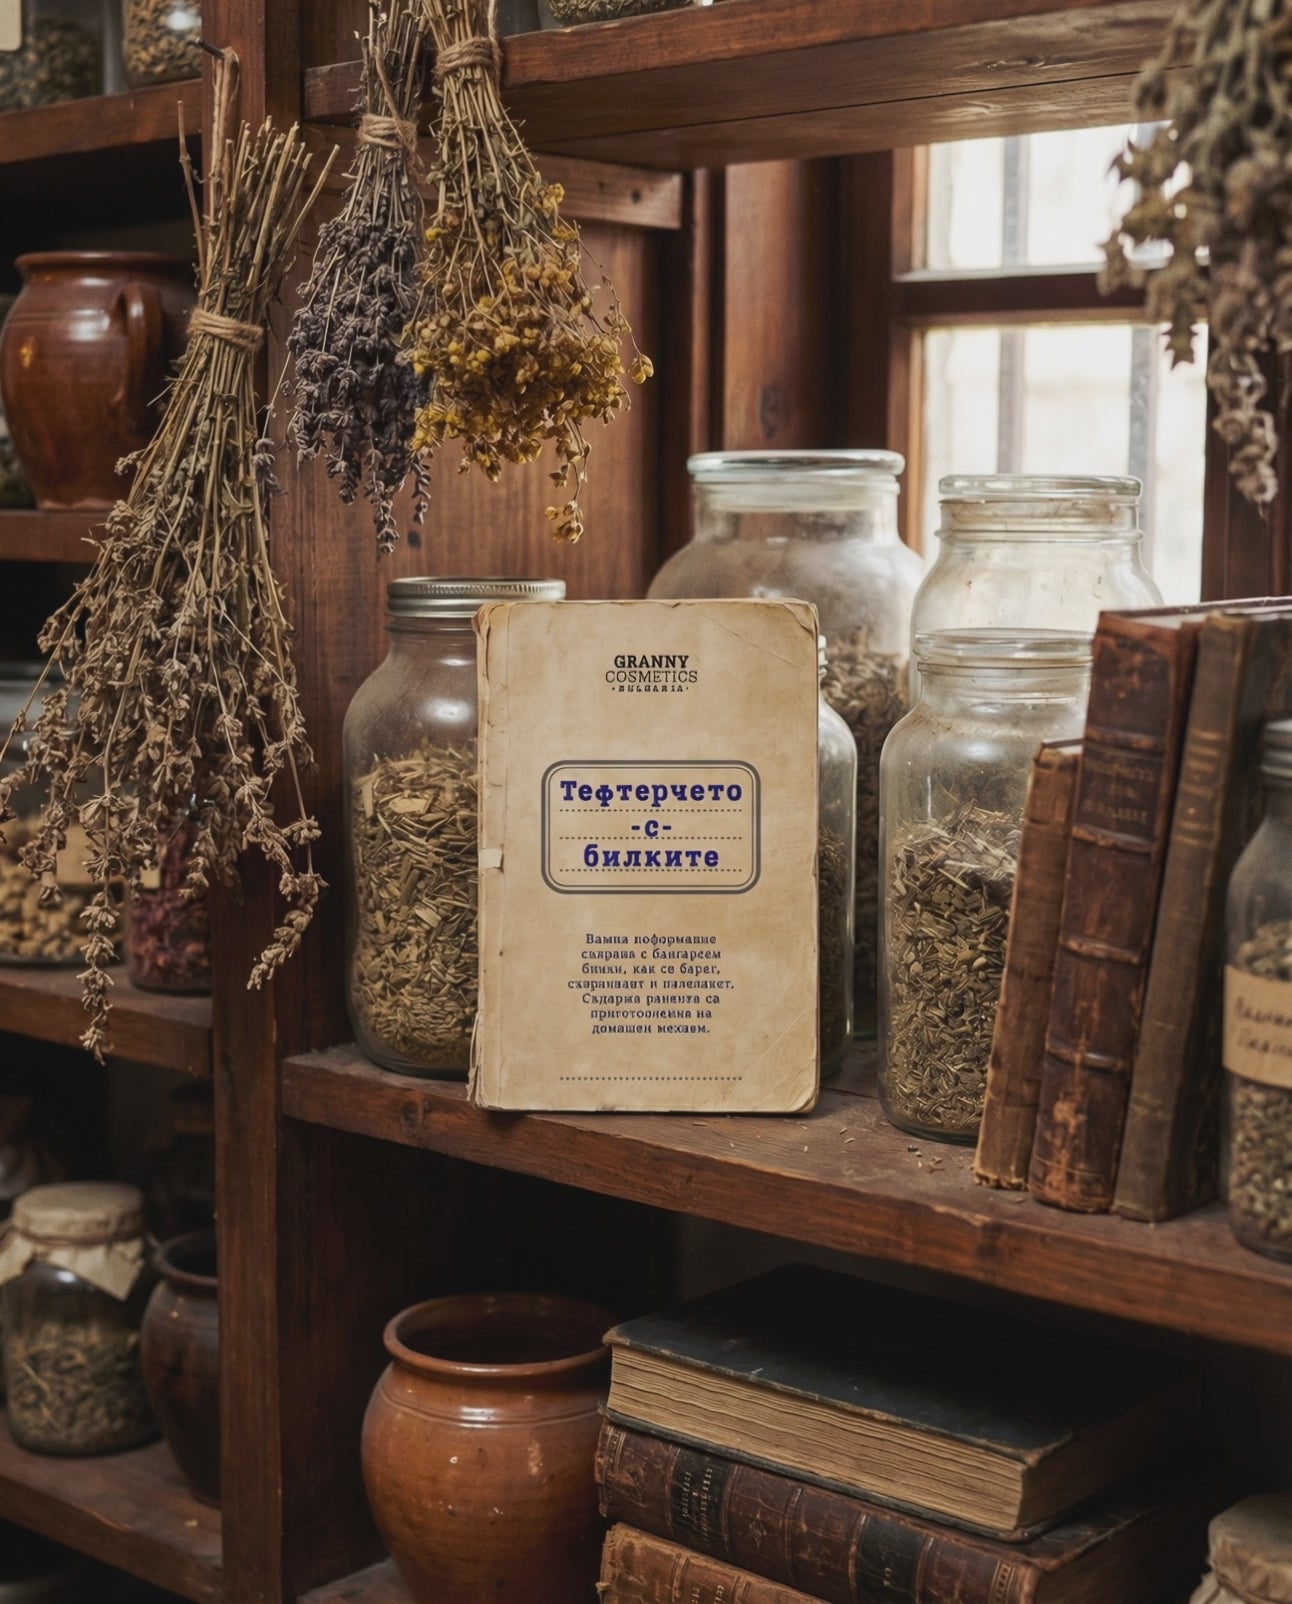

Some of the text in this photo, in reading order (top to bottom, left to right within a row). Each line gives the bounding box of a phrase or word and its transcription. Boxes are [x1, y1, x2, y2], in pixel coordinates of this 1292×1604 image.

[614, 654, 690, 669] GRANNY
[605, 670, 698, 684] COSMETICS
[559, 780, 743, 808] Тефтерчето
[583, 843, 720, 868] билките
